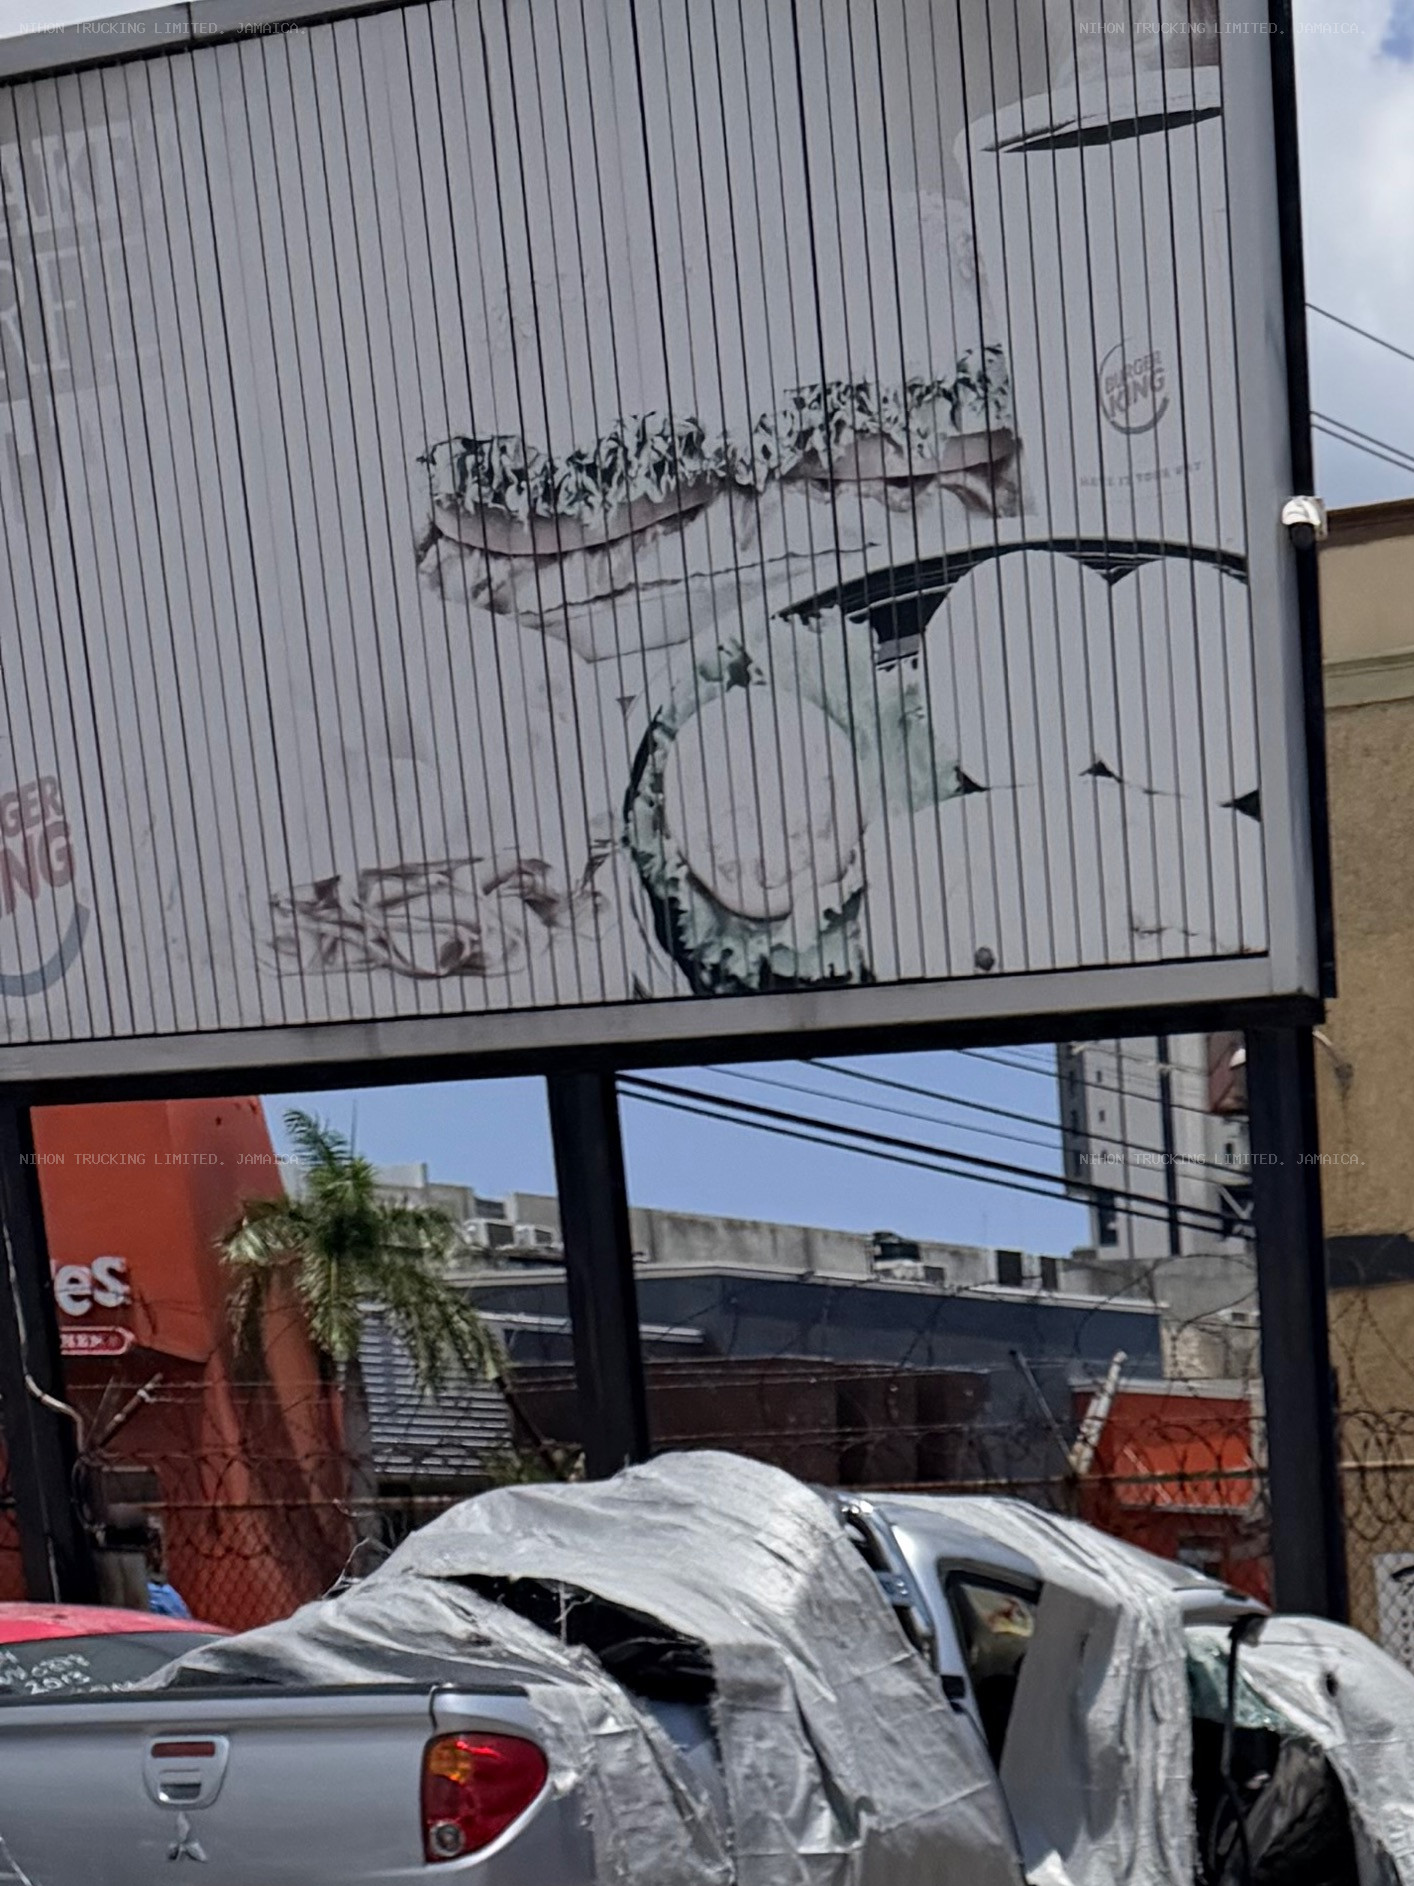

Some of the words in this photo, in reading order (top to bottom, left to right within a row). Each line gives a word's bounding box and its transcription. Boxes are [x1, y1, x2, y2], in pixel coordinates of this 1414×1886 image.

[1108, 367, 1166, 418] KING
[0, 821, 77, 917] NG
[51, 1256, 132, 1317] es
